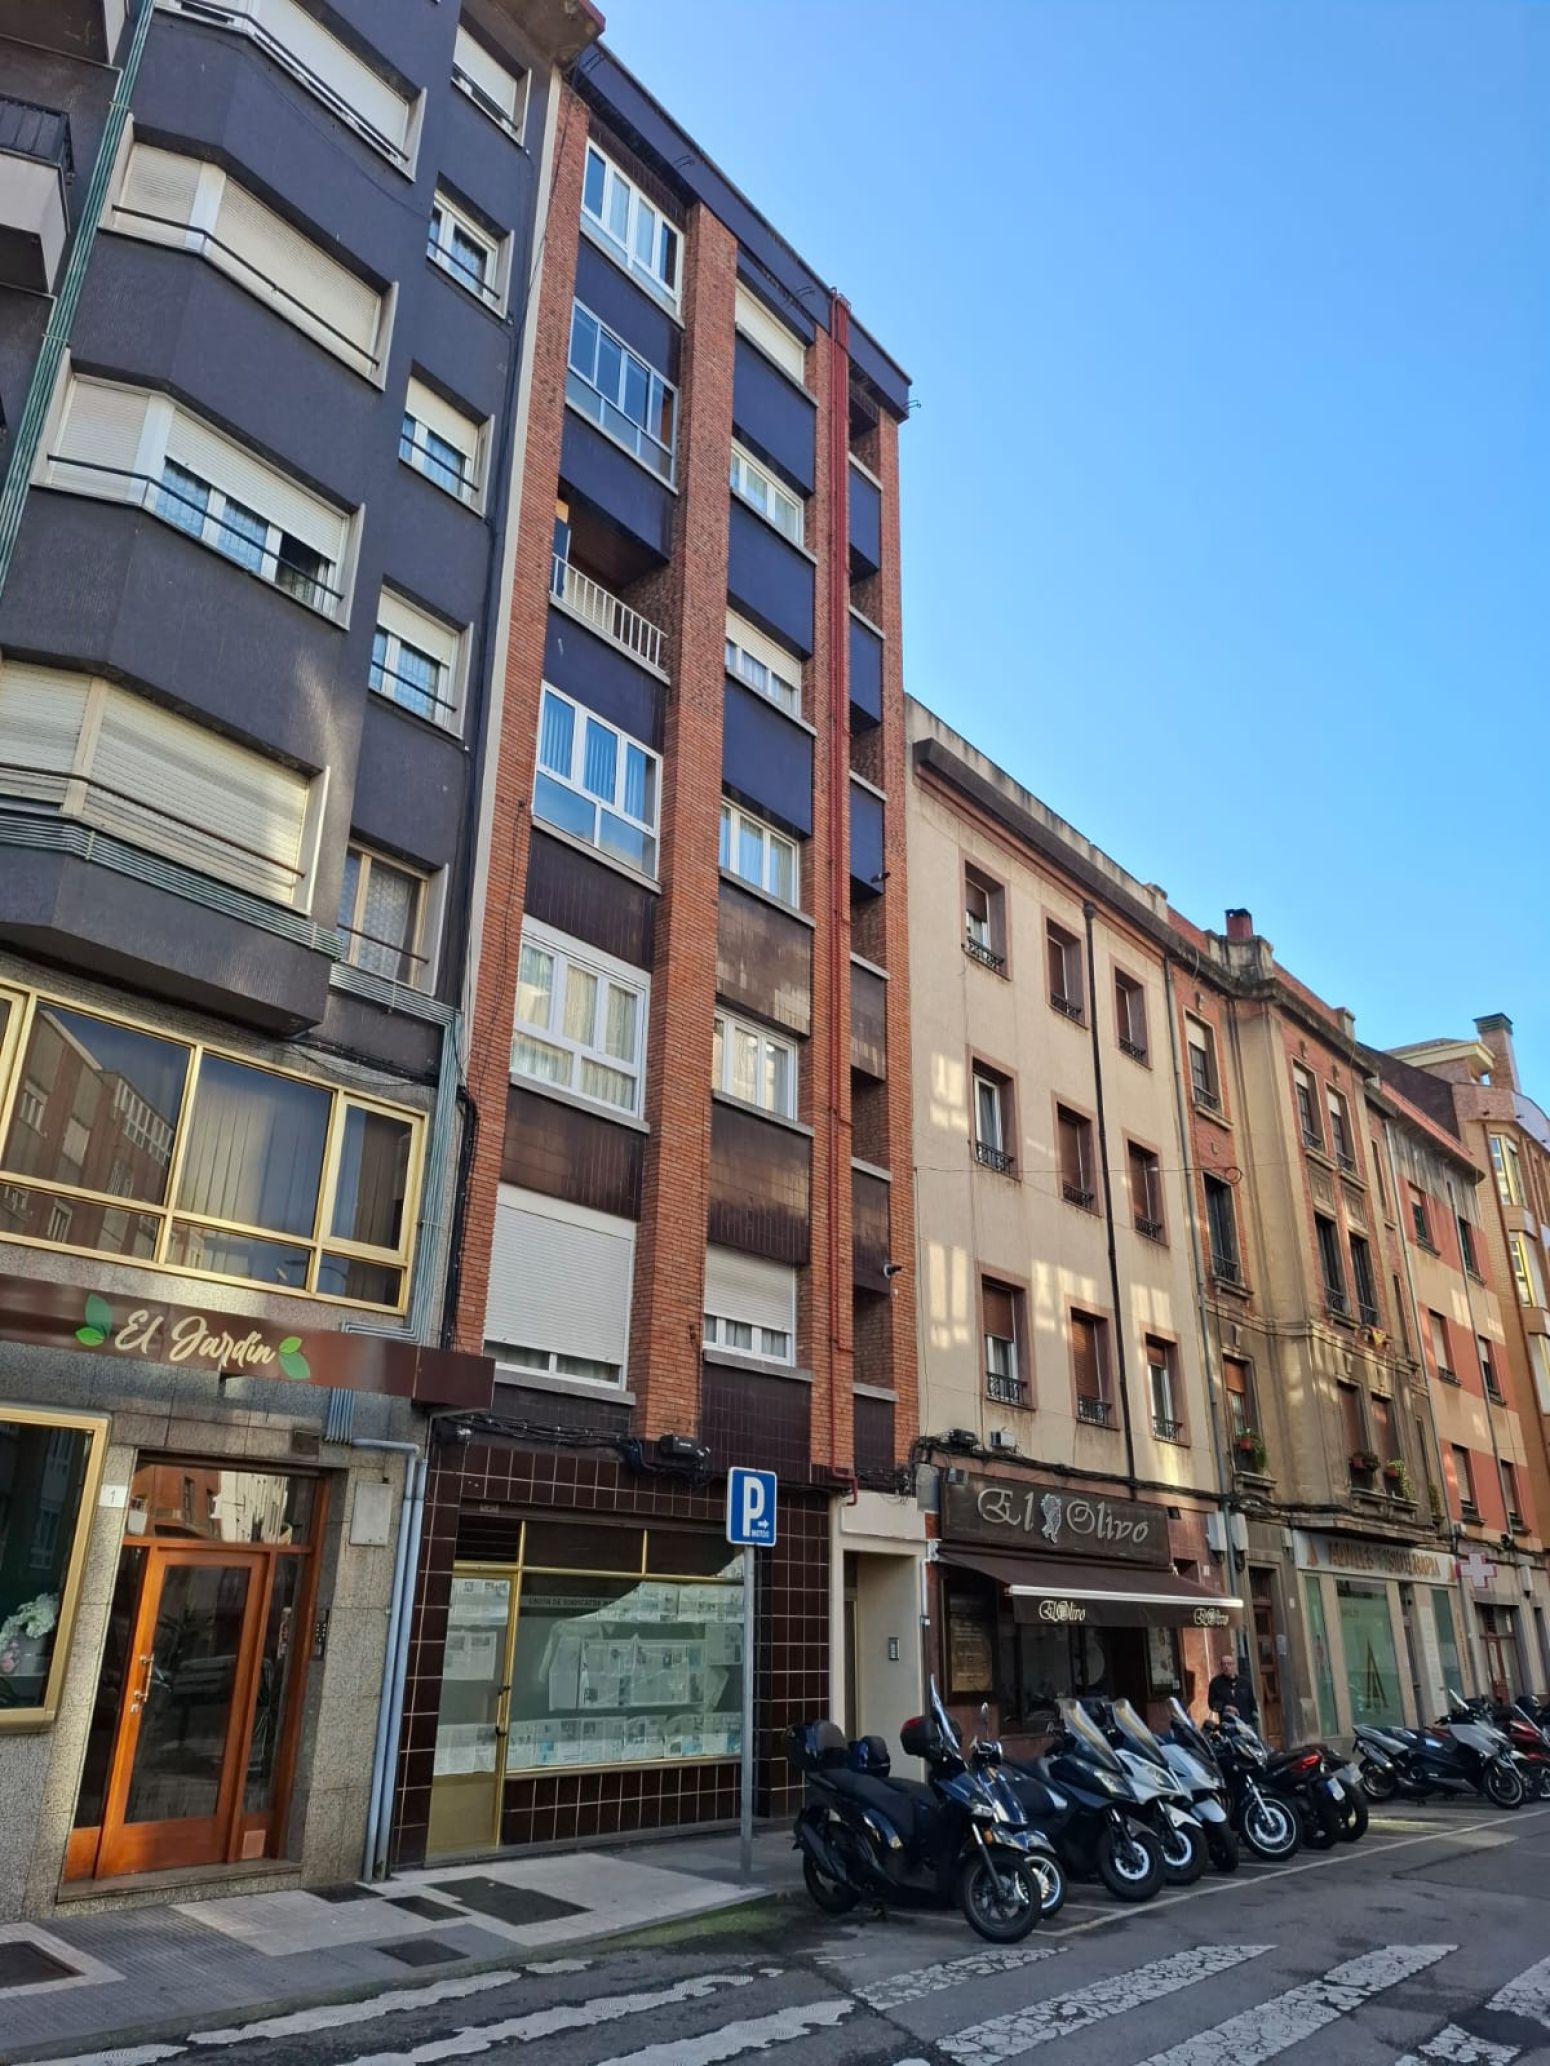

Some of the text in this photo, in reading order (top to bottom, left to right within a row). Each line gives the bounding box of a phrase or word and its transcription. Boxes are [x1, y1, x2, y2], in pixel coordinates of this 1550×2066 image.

[115, 1309, 164, 1354] El
[743, 1476, 765, 1537] P
[977, 1488, 1149, 1543] El Olivo
